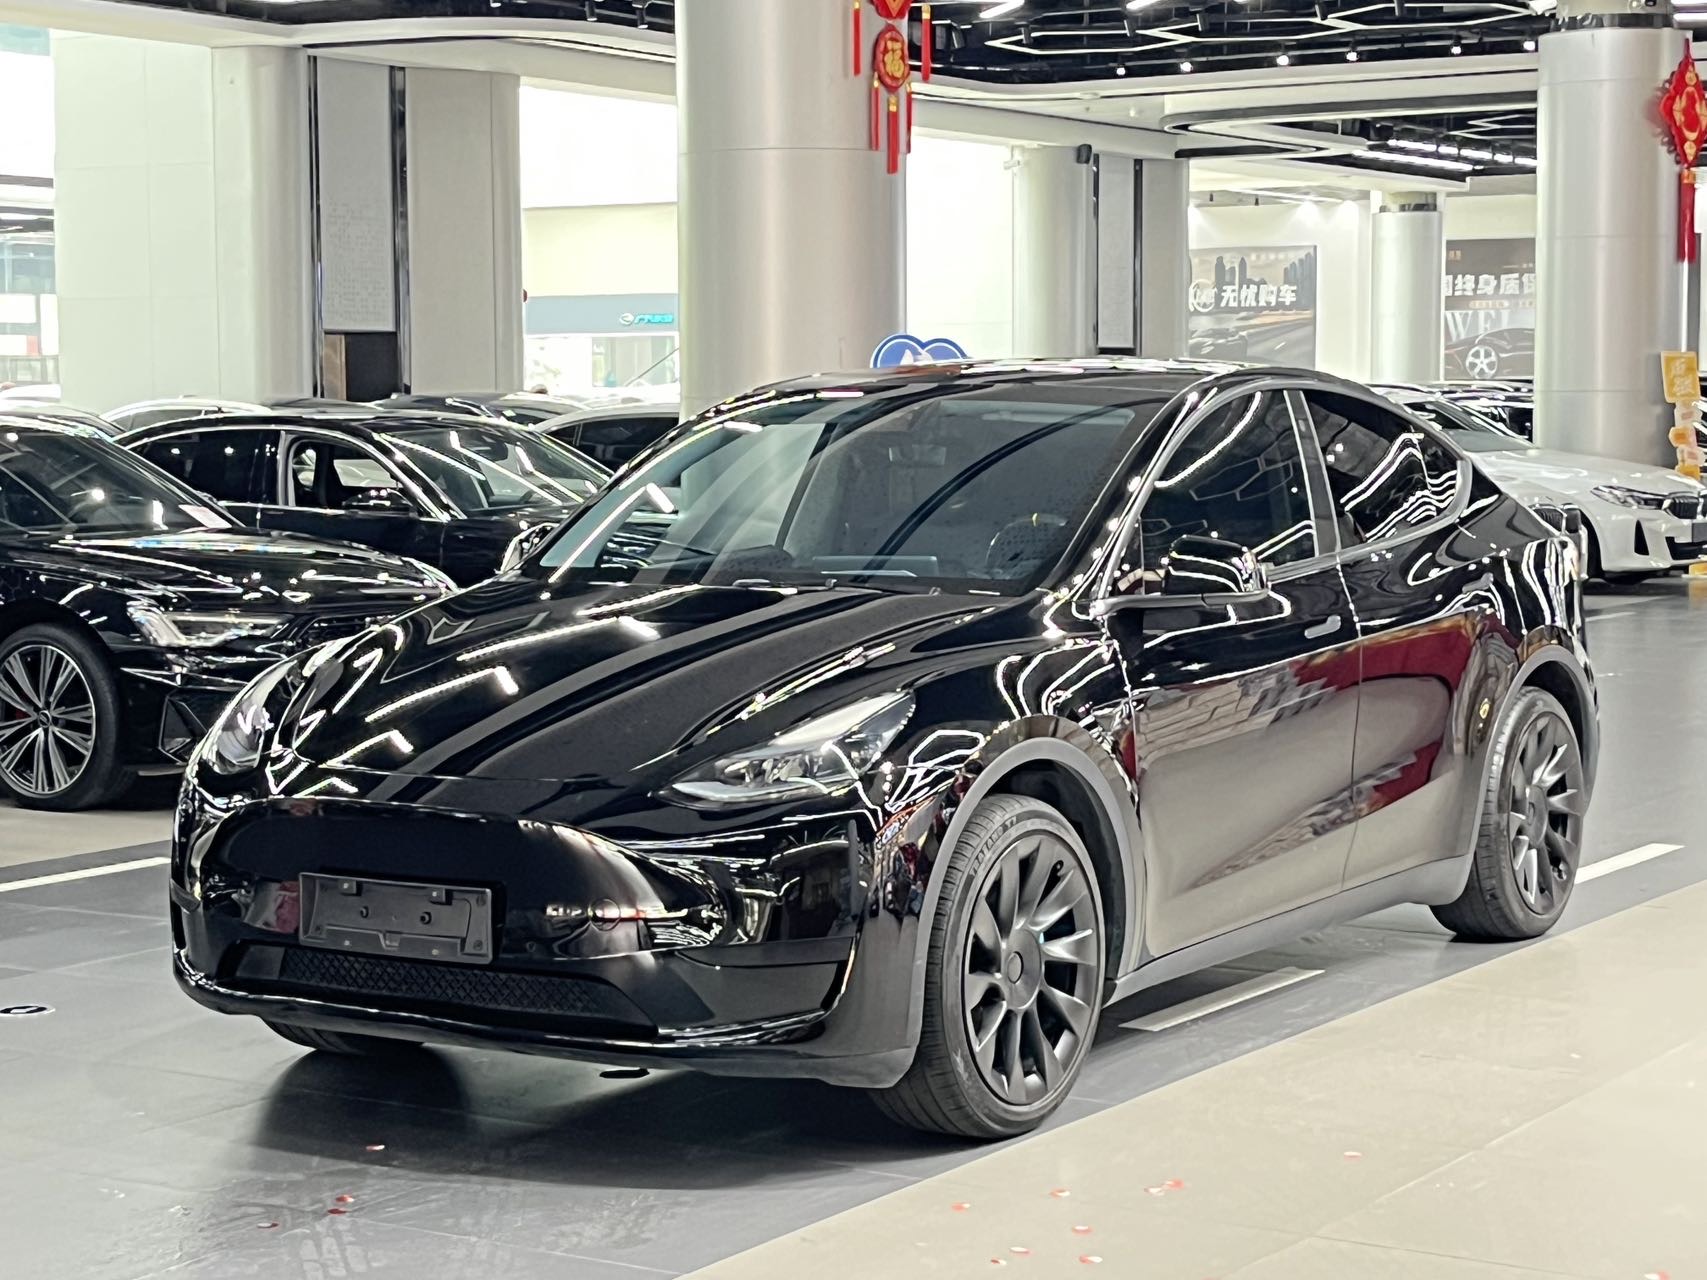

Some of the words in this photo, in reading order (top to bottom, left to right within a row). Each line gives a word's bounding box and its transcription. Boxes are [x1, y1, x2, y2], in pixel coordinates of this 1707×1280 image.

[884, 40, 905, 78] 福
[1220, 284, 1298, 308] 无忧购车
